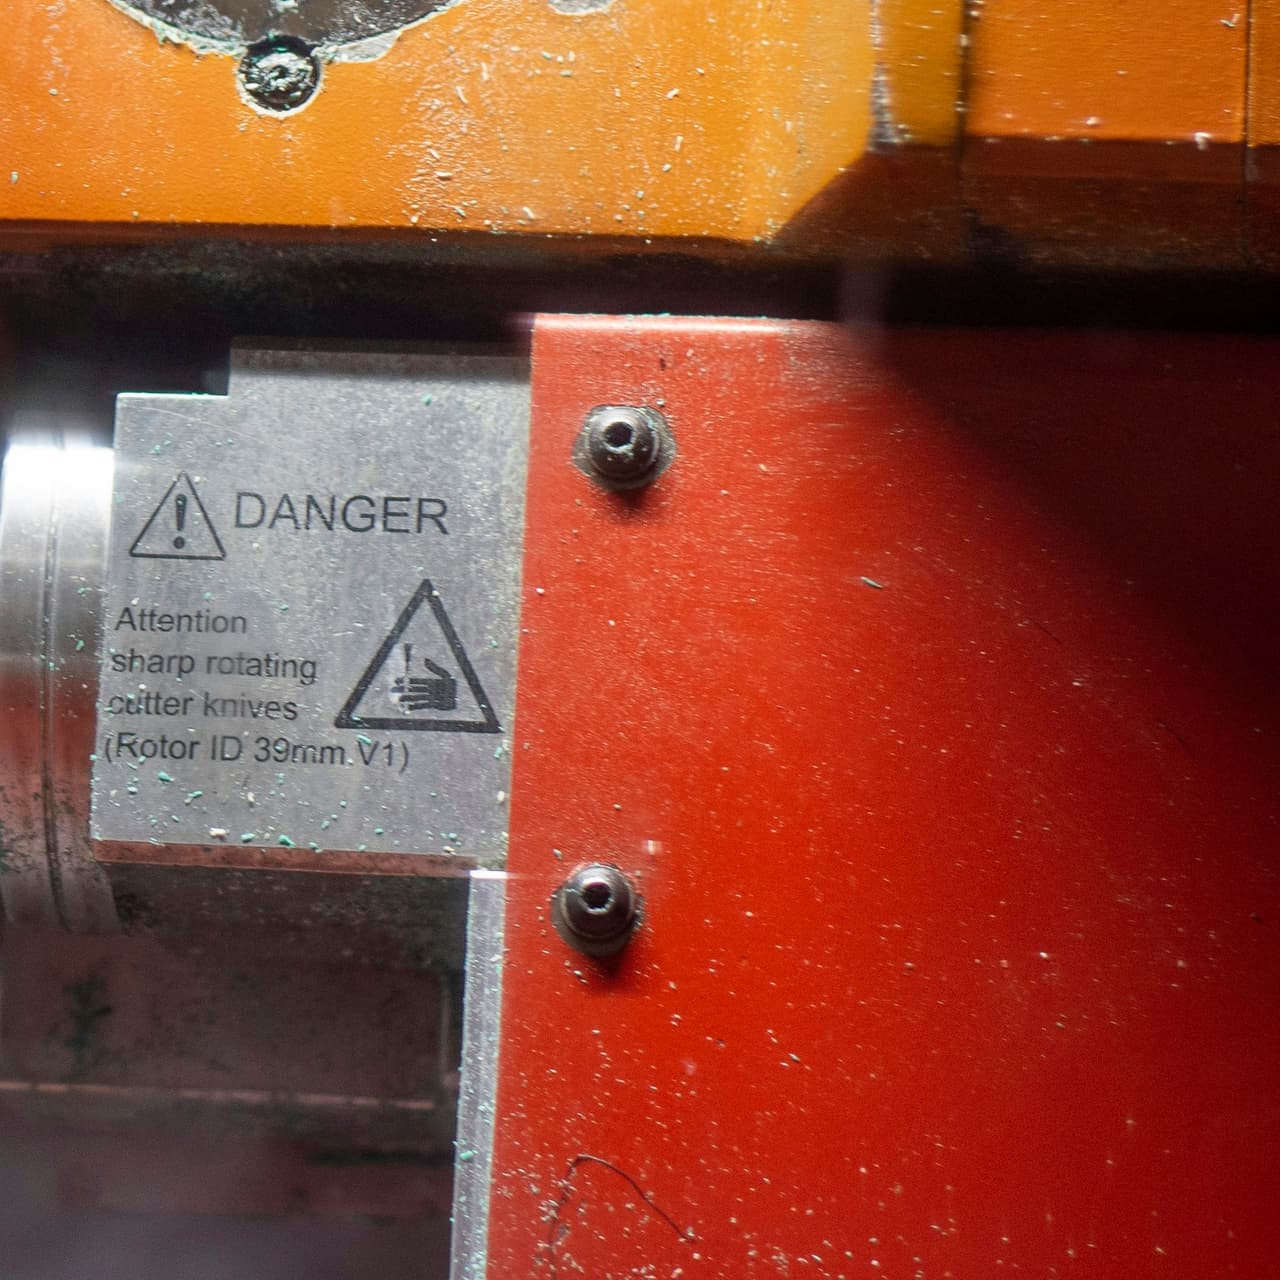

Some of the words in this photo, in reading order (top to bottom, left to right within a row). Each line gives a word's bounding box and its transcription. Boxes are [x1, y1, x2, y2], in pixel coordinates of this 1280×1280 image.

[234, 491, 450, 535] DANGER
[114, 606, 247, 634] Attention
[111, 648, 195, 679] sharp
[206, 651, 317, 686] rotating
[108, 694, 193, 717] cutter
[204, 693, 298, 721] knives
[104, 732, 201, 764] (Rotor
[211, 734, 241, 761] ID
[254, 737, 345, 765] 39mm
[356, 741, 410, 775] V1)
